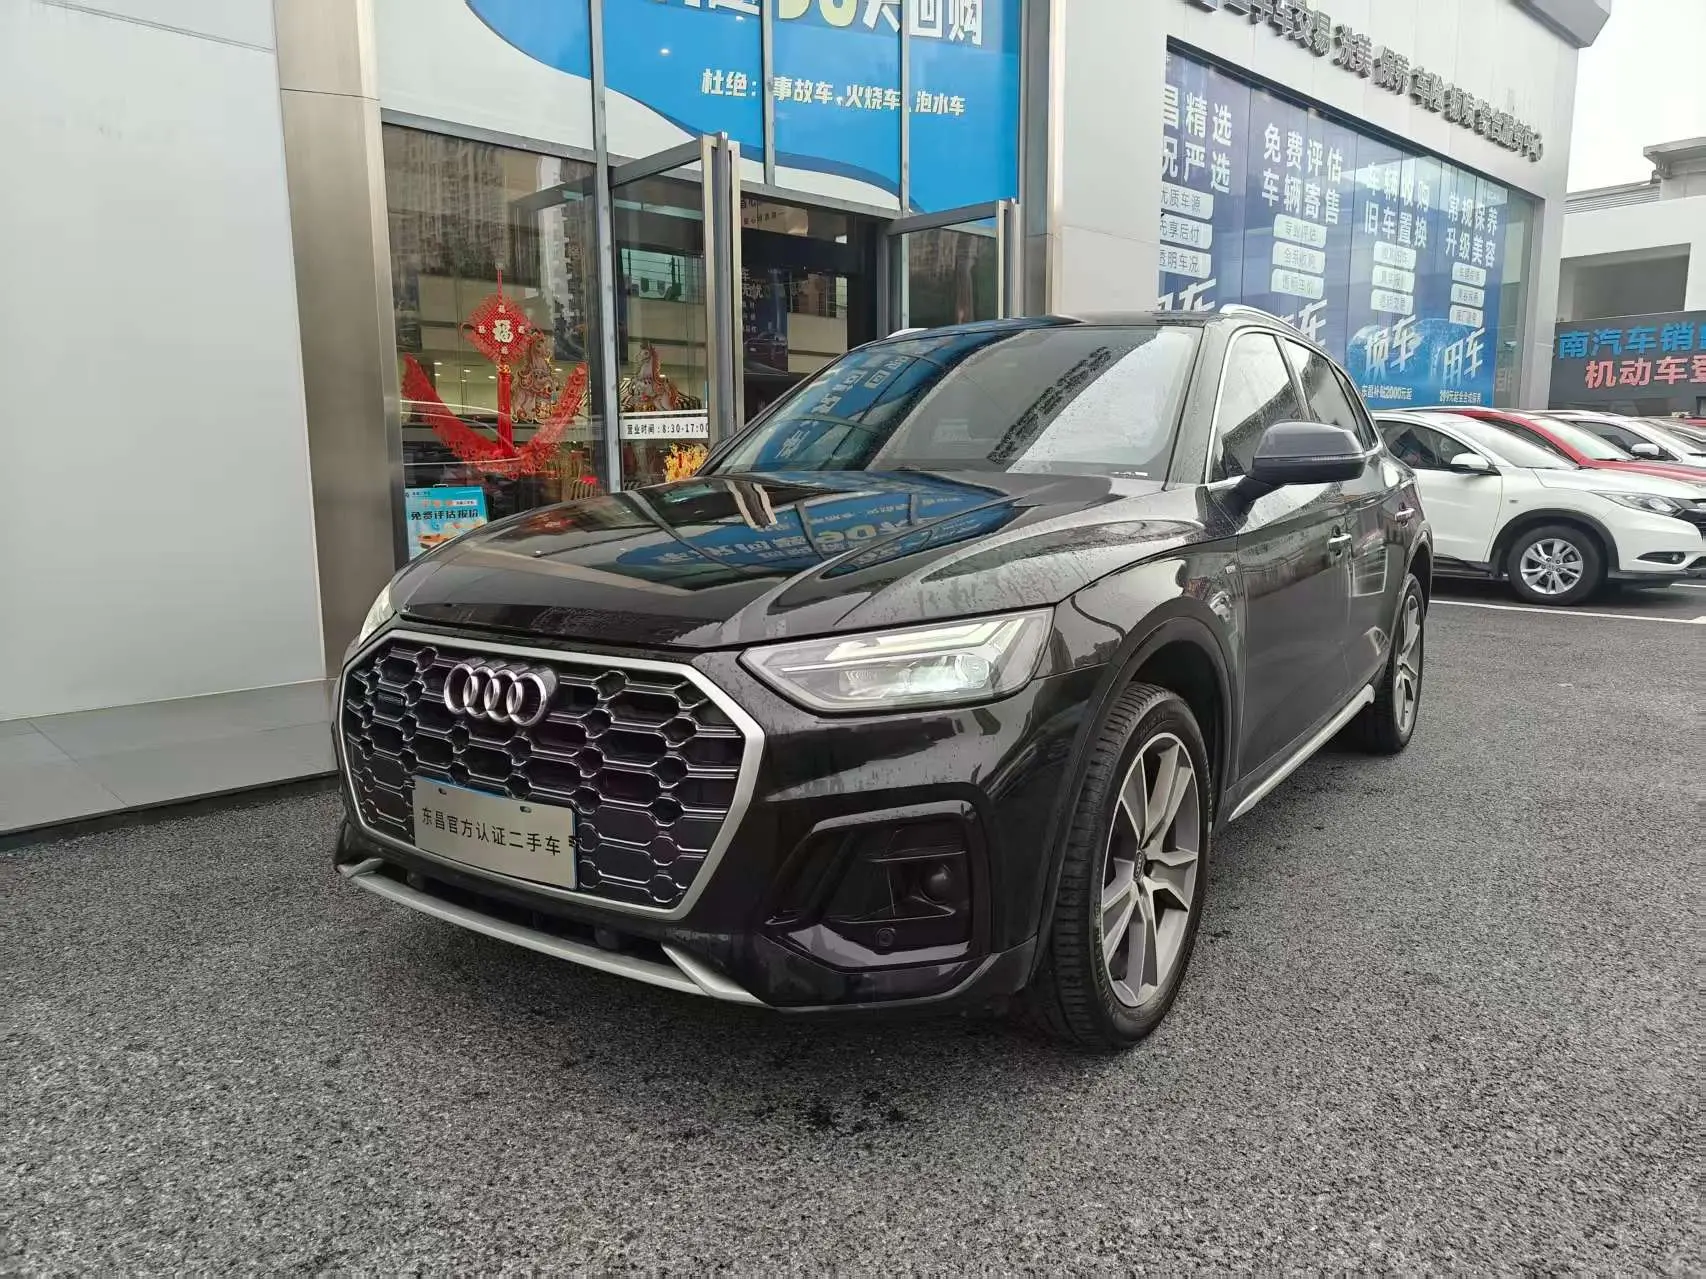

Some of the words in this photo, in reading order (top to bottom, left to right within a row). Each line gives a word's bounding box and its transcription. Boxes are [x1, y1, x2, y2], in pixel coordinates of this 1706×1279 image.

[1263, 122, 1343, 185] 免费评估
[1364, 200, 1427, 249] 旧车置换
[1448, 191, 1499, 237] 常规保养
[1445, 227, 1496, 269] 升级美容
[1559, 323, 1706, 359] 南汽车销
